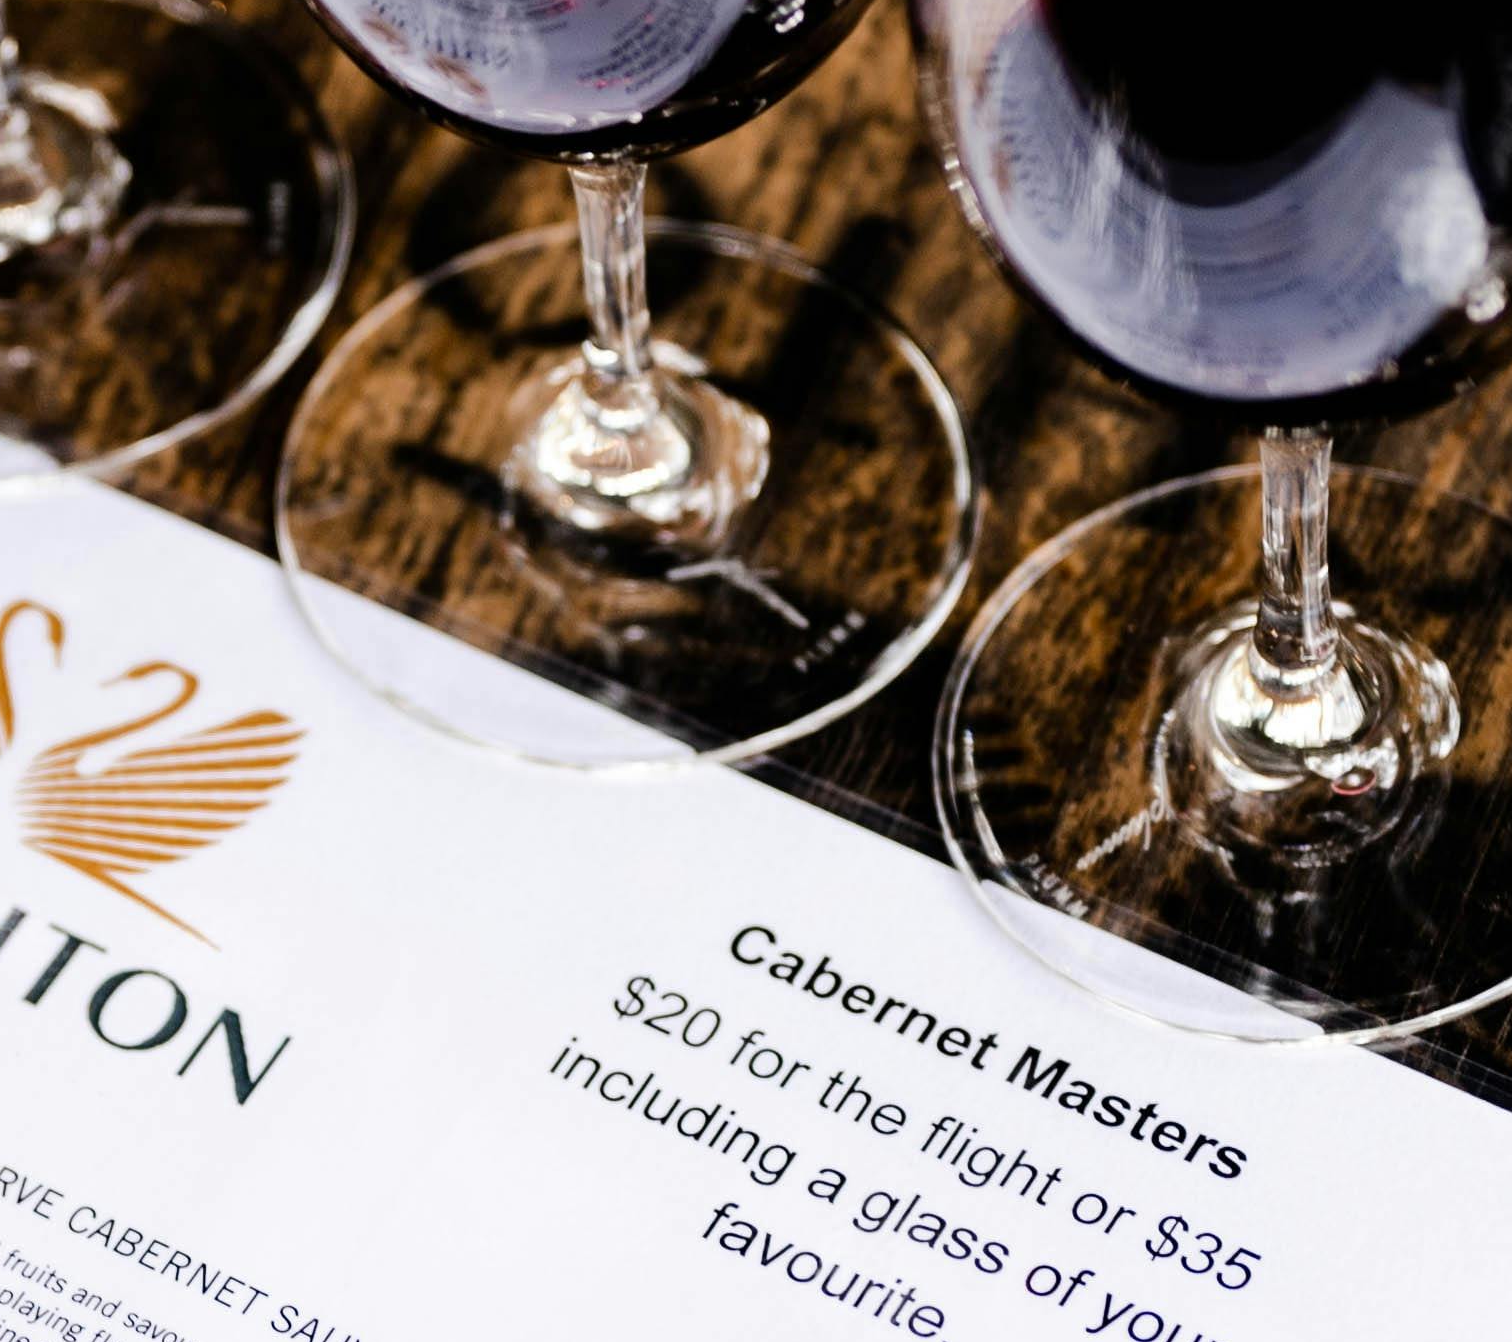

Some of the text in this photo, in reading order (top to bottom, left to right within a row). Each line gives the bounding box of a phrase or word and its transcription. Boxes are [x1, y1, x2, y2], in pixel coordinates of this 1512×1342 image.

[549, 1036, 797, 1186] including
[807, 1168, 847, 1204] a
[852, 1191, 1010, 1274] glass
[1025, 1264, 1096, 1307] of
[613, 976, 1262, 1290] $20 for the flight or $35
[730, 925, 1248, 1179] Cabernet Masters
[3, 1249, 67, 1294] fruits
[71, 1288, 122, 1318] and
[68, 1206, 269, 1315] CABERNET
